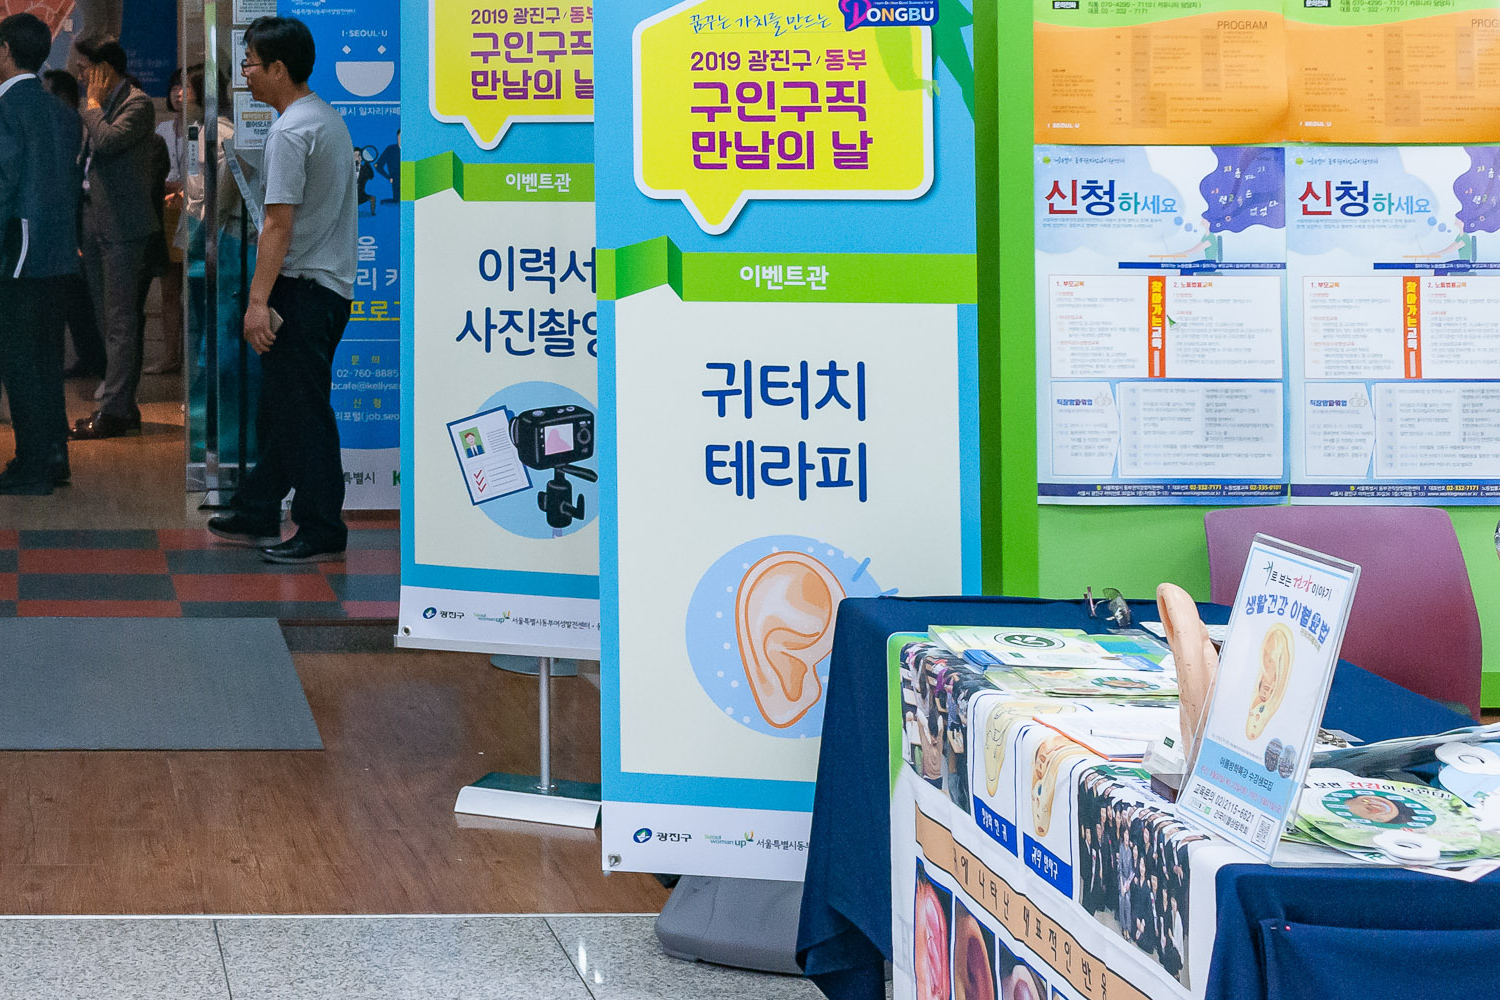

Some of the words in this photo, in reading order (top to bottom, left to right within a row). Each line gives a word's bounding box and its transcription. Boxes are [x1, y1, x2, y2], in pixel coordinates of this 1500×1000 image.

[470, 9, 508, 25] 2019
[688, 13, 732, 35] 꿈꾸는
[734, 12, 782, 37] 가치를
[784, 13, 833, 30] 만드는
[1216, 20, 1269, 30] PROGRAM
[690, 50, 741, 72] 2019
[471, 69, 561, 101] 만남의
[690, 79, 867, 123] 구인구직
[691, 130, 816, 171] 만남의
[831, 129, 874, 171] 날
[505, 172, 572, 194] 이벤트관
[1045, 179, 1178, 216] 신청하세요
[1298, 180, 1432, 217] 신청하세요
[739, 264, 829, 292] 이벤트관
[1151, 280, 1163, 327] 찾아가는
[1406, 281, 1418, 328] 찾아가는
[1151, 327, 1163, 350] 교육
[1406, 327, 1418, 351] 교육
[701, 359, 867, 422] 귀터치
[704, 439, 868, 504] 테라피
[1311, 583, 1332, 601] 이야기
[1245, 594, 1289, 616] 생활건강
[1346, 781, 1396, 792] 건강이
[656, 831, 692, 843] 광진구
[734, 839, 747, 848] up
